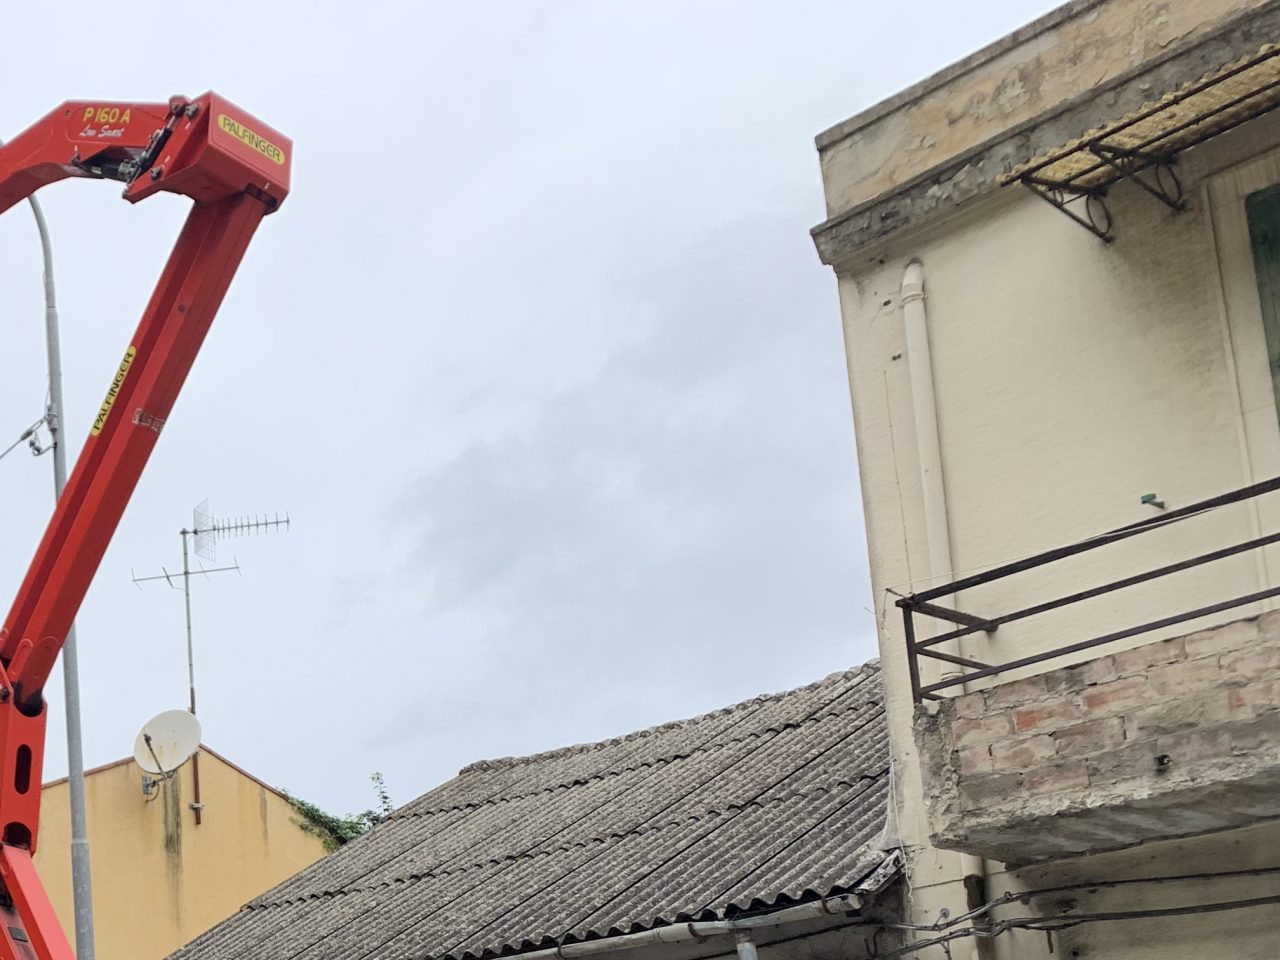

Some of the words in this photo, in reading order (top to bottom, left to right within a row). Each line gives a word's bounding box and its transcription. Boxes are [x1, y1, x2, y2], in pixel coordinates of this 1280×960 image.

[82, 107, 94, 122] P
[95, 107, 119, 122] 160
[120, 108, 131, 123] A
[222, 116, 282, 162] PALFINGER
[92, 352, 134, 431] PALFINGER
